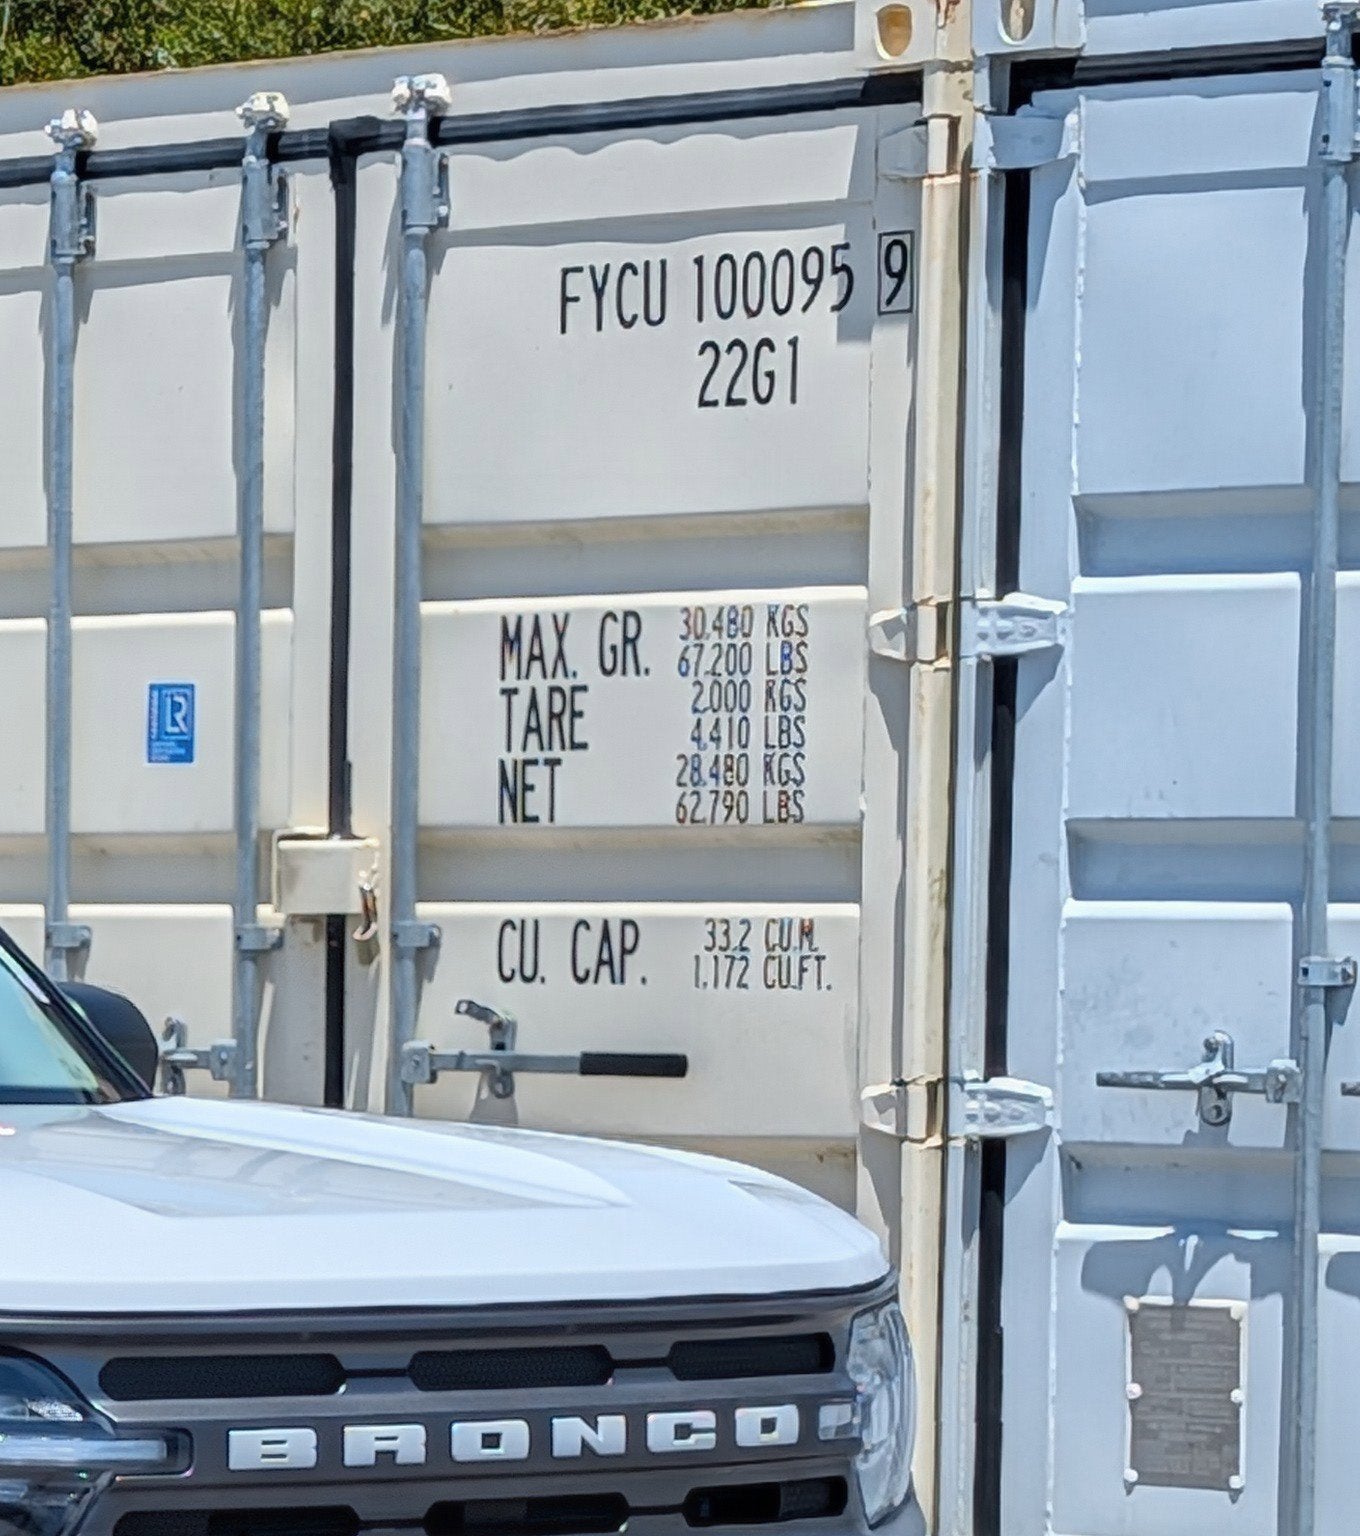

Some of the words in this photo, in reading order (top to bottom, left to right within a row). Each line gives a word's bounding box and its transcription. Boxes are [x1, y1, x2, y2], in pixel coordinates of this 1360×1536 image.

[559, 258, 668, 335] FYCU
[692, 242, 856, 324] 100095
[883, 238, 909, 307] 9
[697, 336, 800, 409] 22G1
[499, 614, 577, 681] MAX.
[599, 610, 650, 678] GR.
[766, 603, 809, 638] KGS
[765, 640, 808, 676] LBS
[499, 685, 589, 752] TARE
[764, 678, 807, 713] KGS
[764, 715, 807, 750] LBS
[497, 757, 563, 824] NET
[763, 752, 807, 787] KGS
[763, 790, 806, 824] LBS
[496, 919, 546, 985] CU.
[570, 918, 648, 986] CAP.
[704, 918, 753, 952] 33.2
[694, 954, 750, 990] 1.172
[227, 1403, 800, 1471] BRONCO
